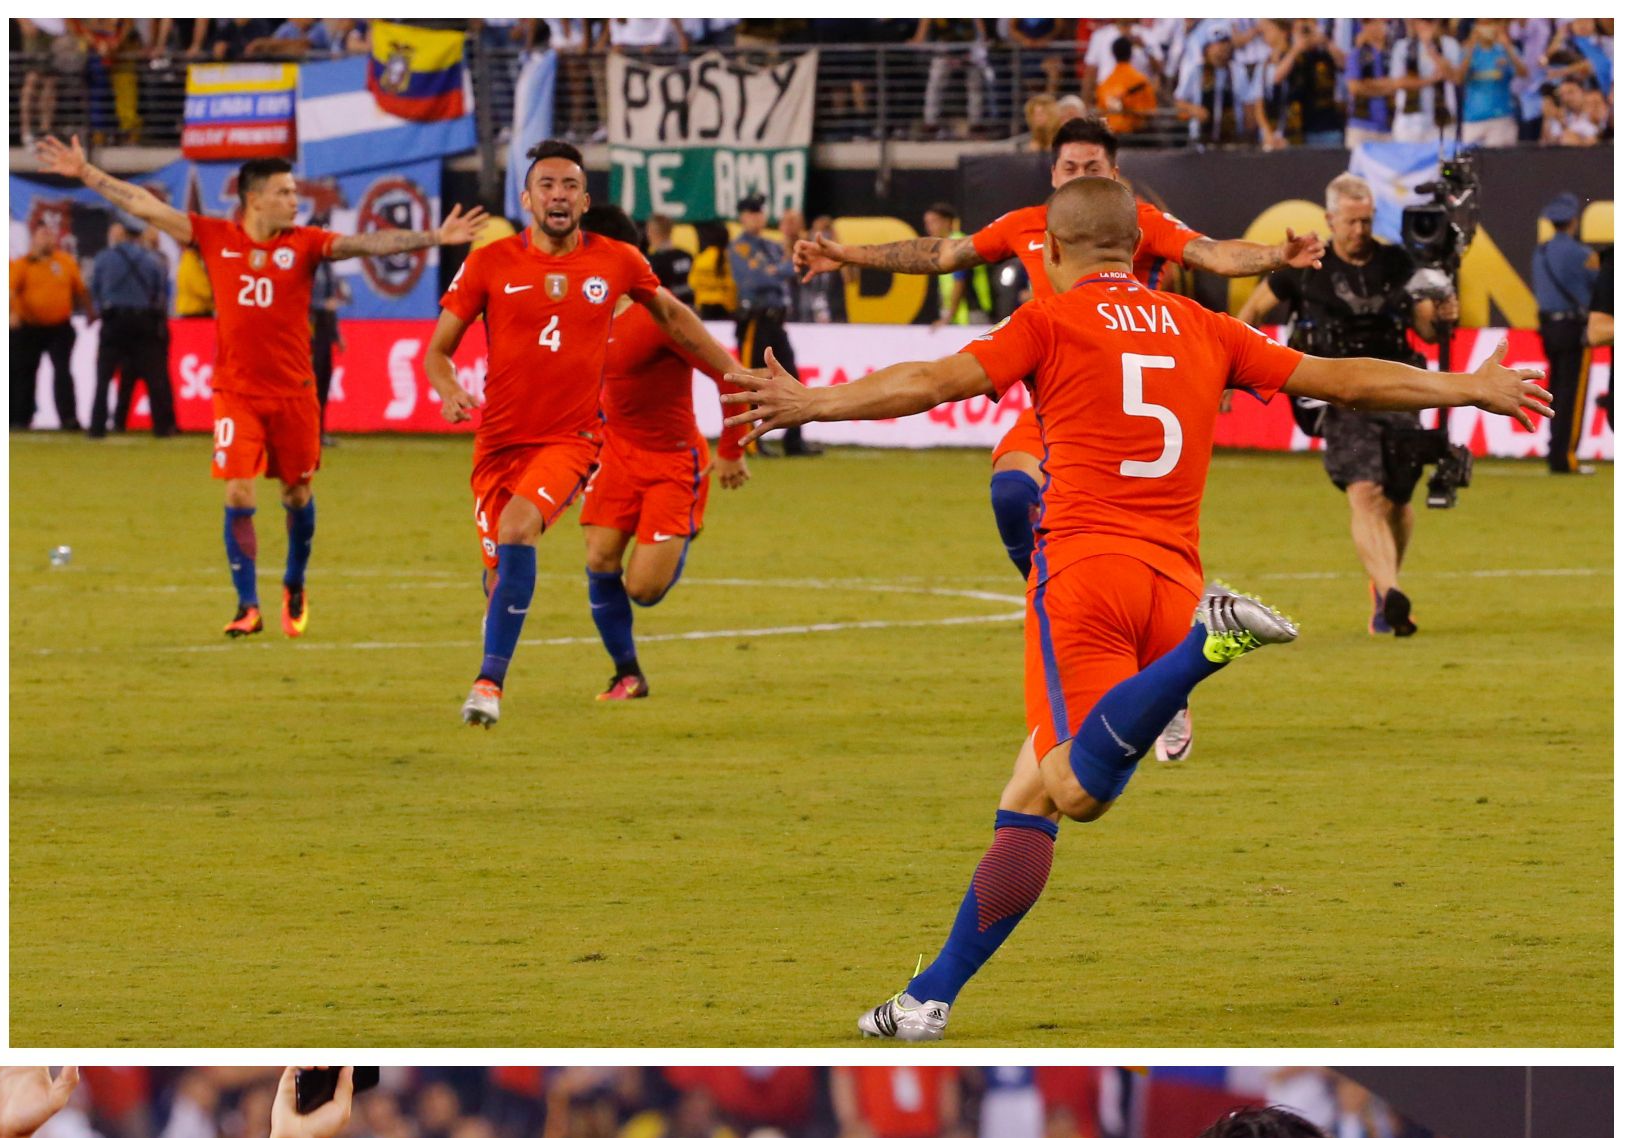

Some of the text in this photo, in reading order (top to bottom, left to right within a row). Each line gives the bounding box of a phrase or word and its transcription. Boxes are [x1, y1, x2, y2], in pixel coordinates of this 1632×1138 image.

[623, 60, 797, 141] PASTY
[611, 150, 806, 220] TE AMA
[237, 274, 274, 307] 20
[538, 315, 562, 352] 4
[1096, 303, 1181, 335] SILVA
[1120, 352, 1183, 478] 5
